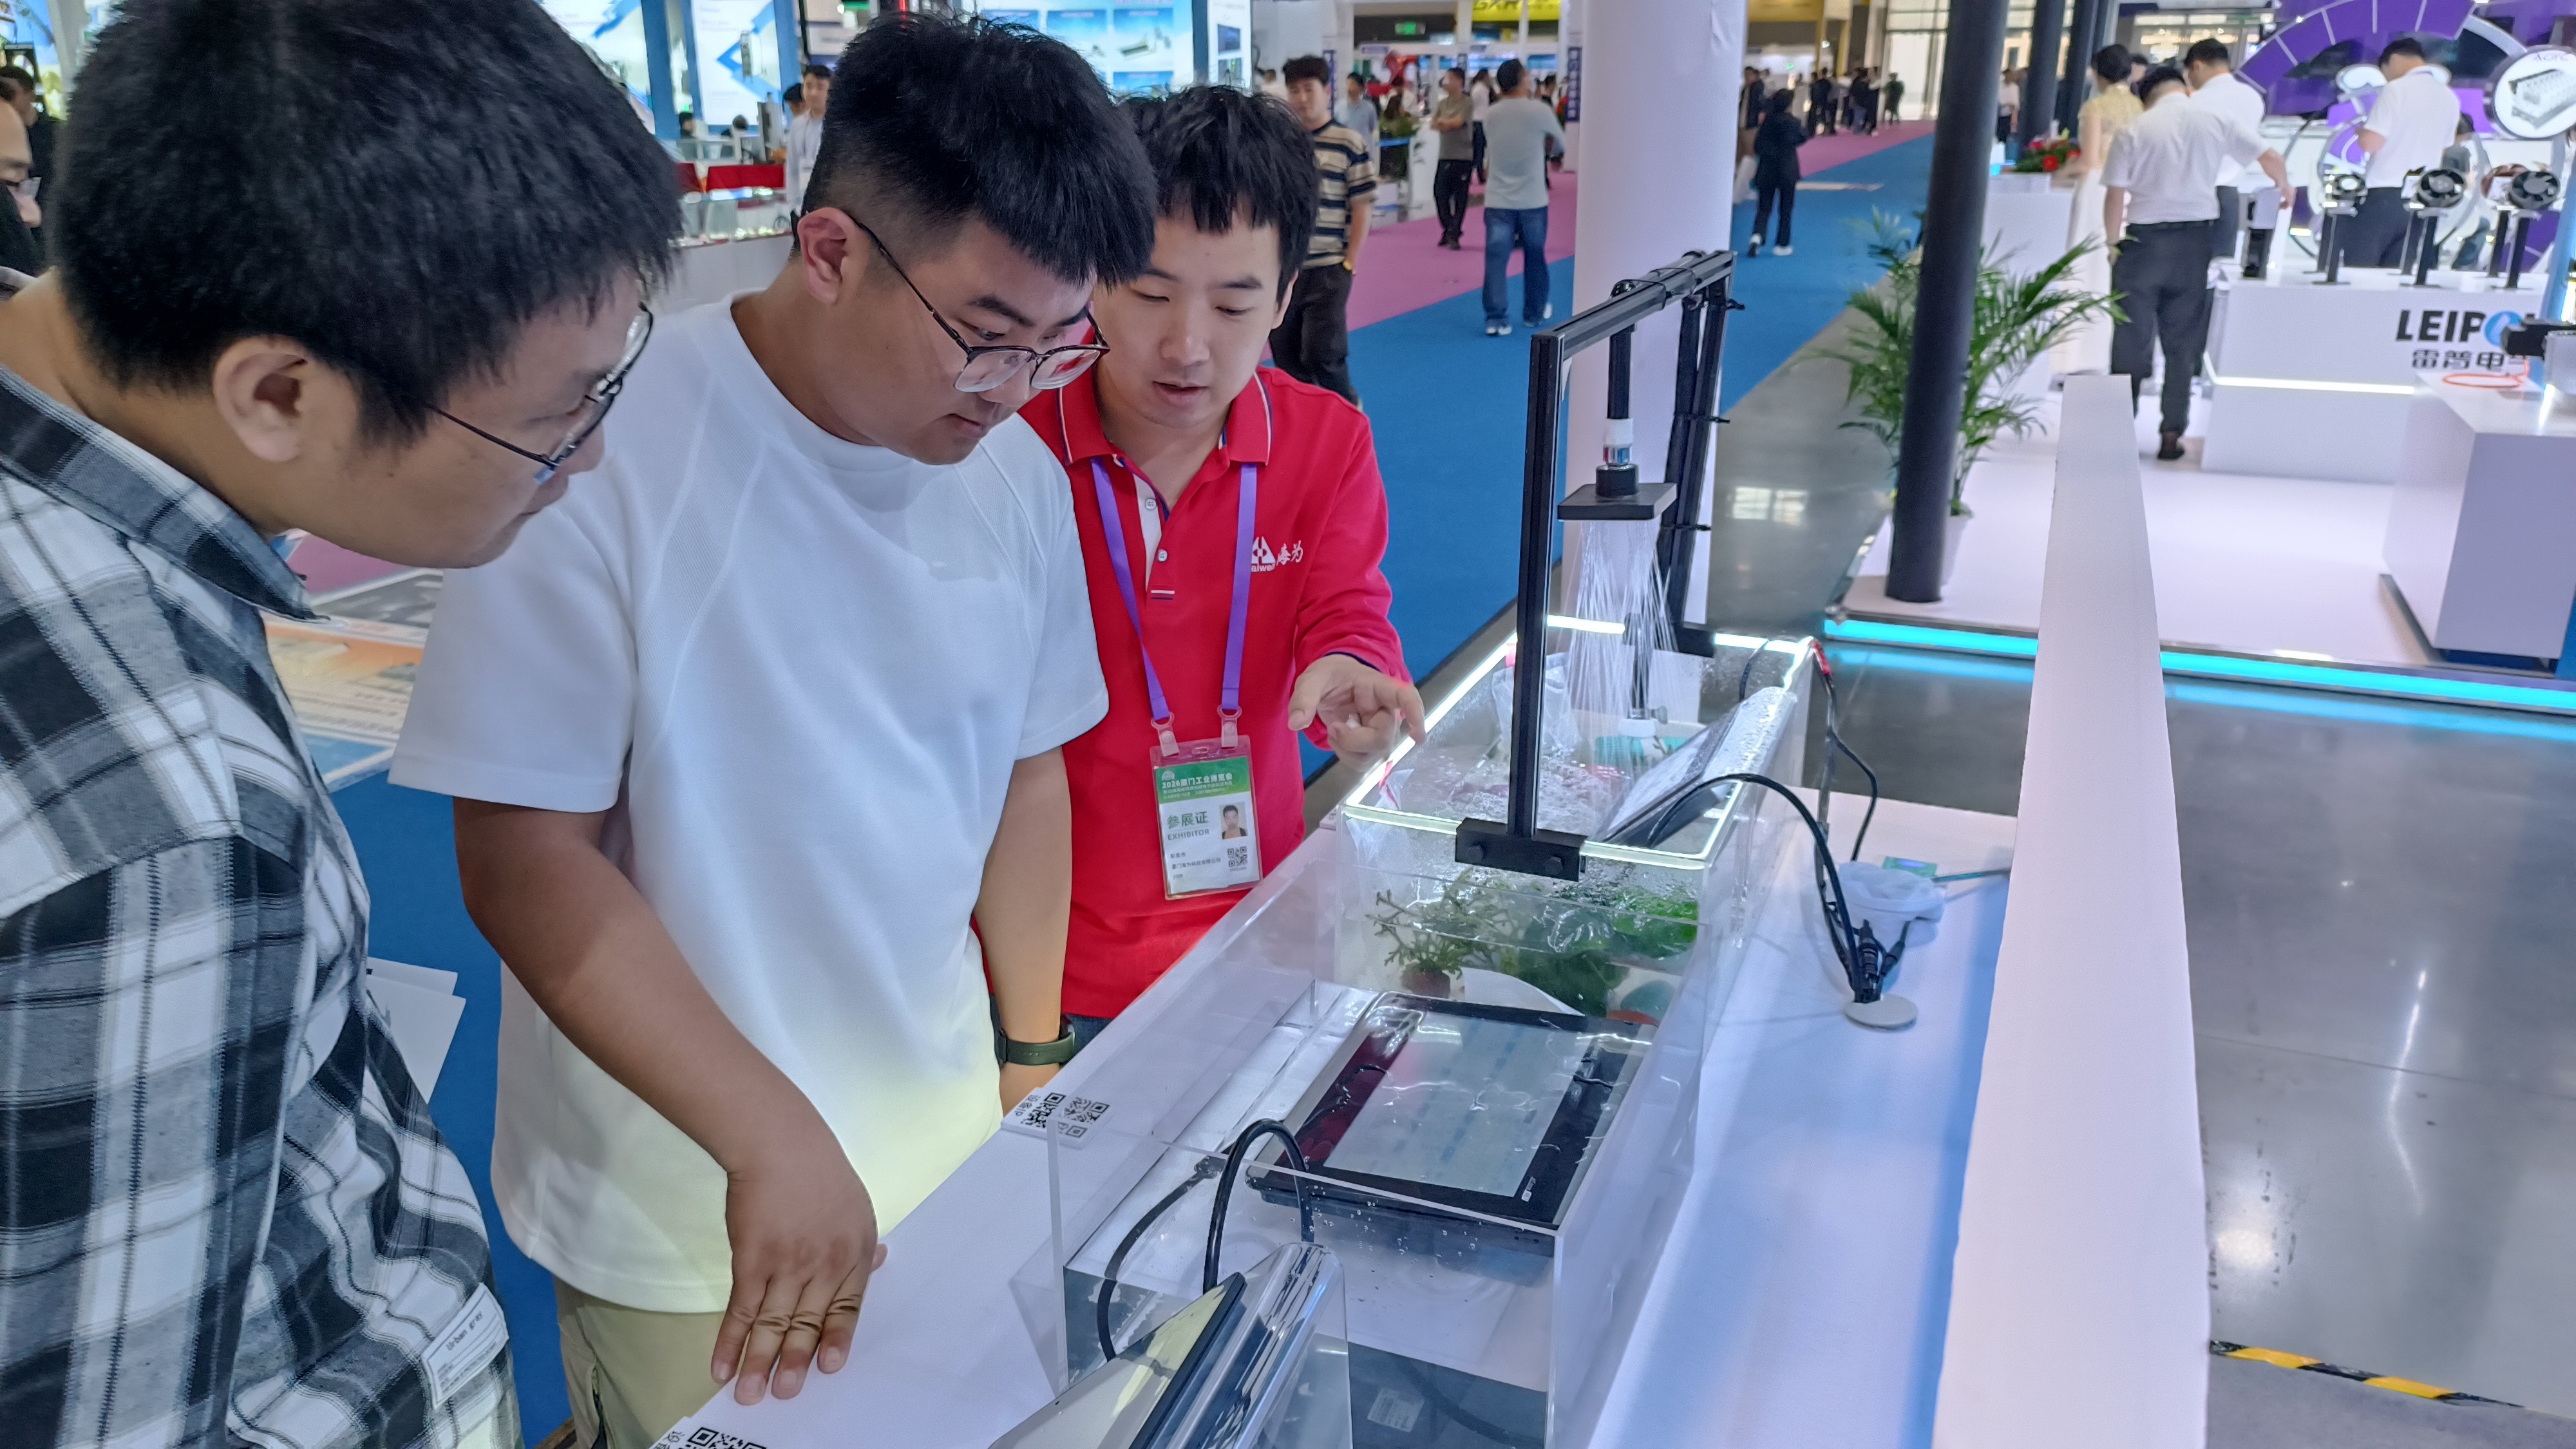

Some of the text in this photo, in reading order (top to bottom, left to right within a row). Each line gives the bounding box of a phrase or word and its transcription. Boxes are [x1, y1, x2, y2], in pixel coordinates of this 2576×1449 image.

[1167, 811, 1208, 829] 参展证
[1168, 829, 1210, 840] EXHIBITOR
